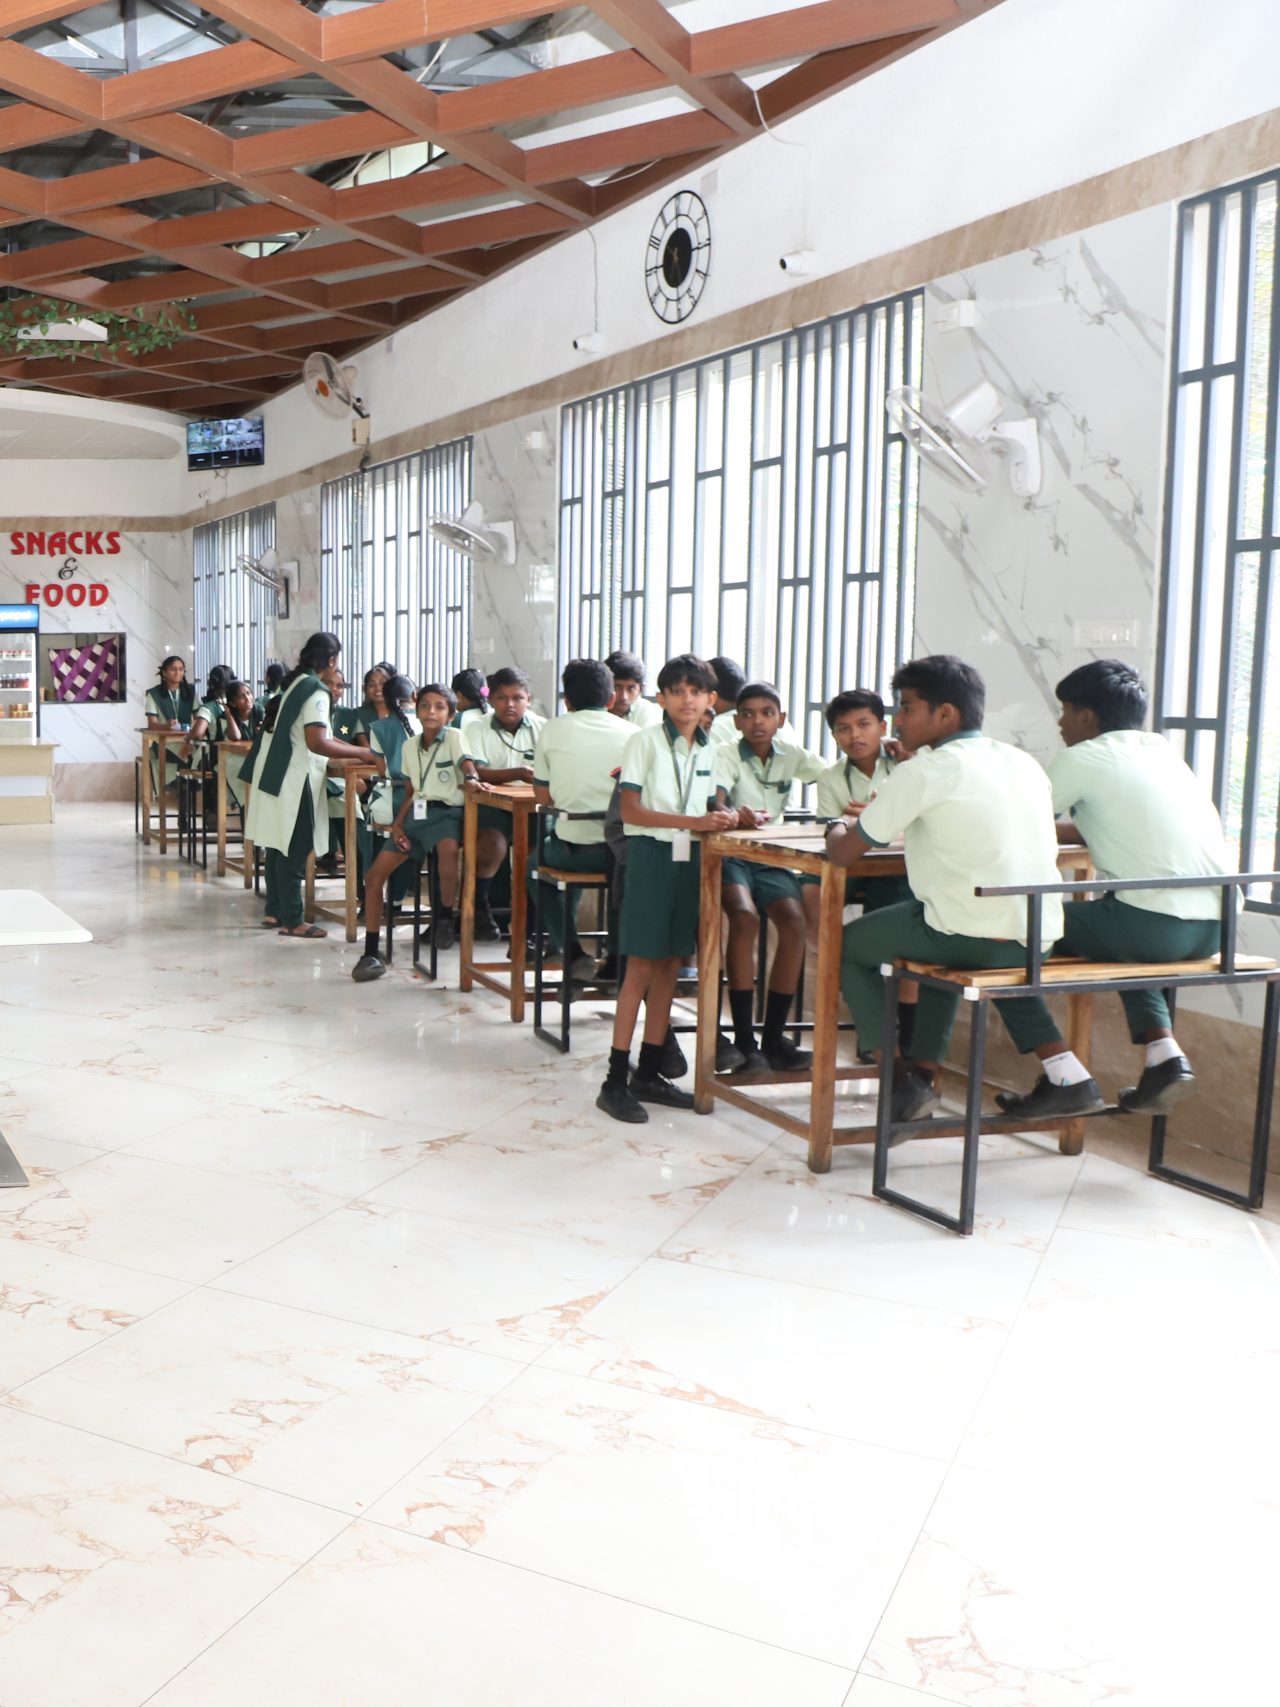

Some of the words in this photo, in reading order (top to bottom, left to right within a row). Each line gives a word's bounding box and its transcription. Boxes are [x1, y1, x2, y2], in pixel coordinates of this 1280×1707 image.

[10, 531, 121, 557] SNACKS
[58, 557, 78, 580] &
[25, 583, 109, 607] FOOD
